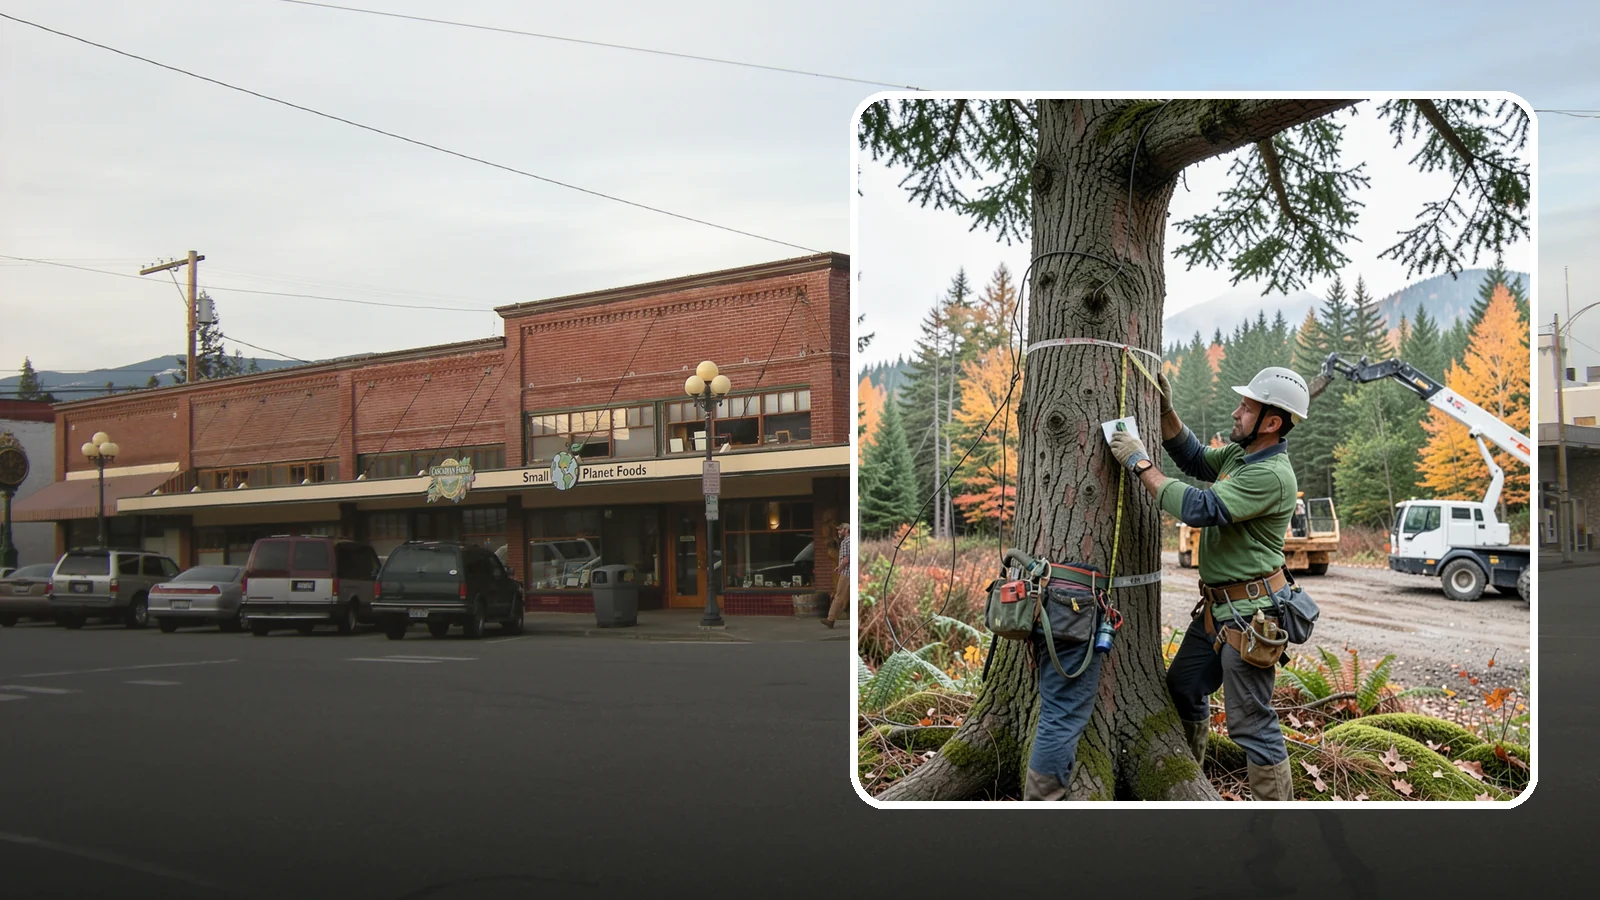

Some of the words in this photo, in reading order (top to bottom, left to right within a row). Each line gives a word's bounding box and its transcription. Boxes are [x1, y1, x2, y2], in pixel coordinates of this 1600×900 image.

[523, 470, 549, 483] Small
[583, 467, 614, 479] Planet
[617, 464, 647, 477] Foods
